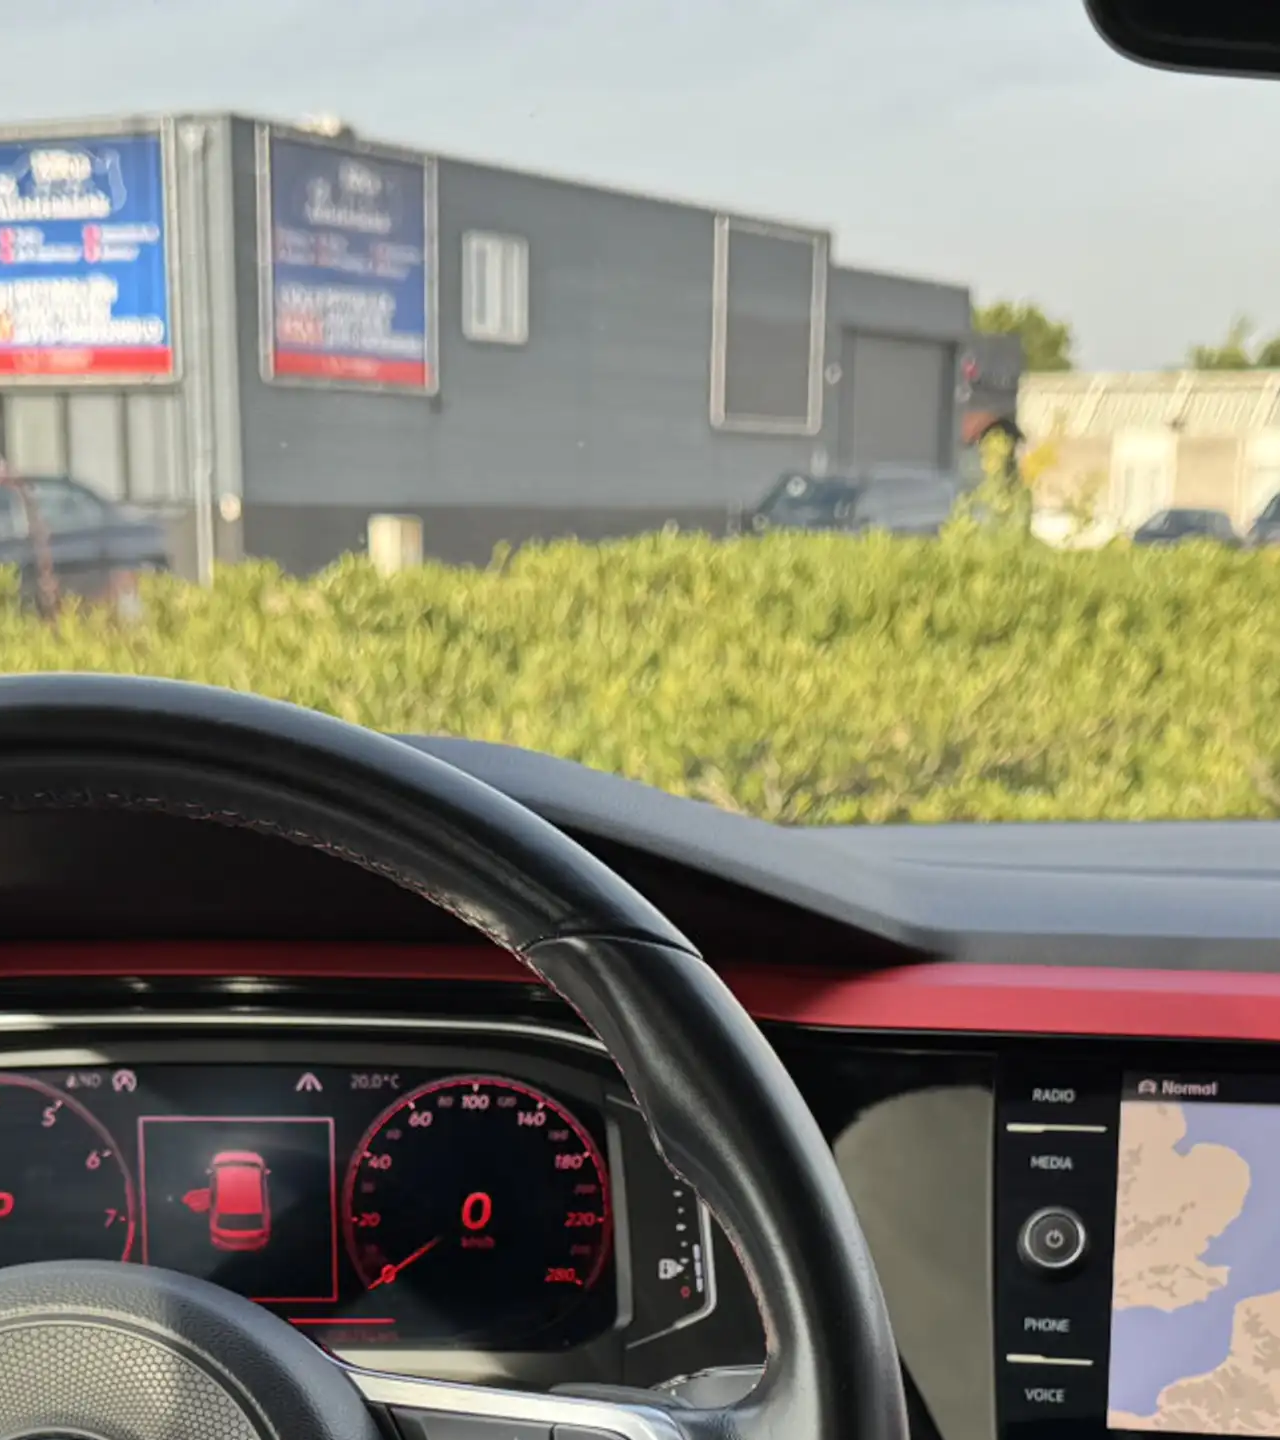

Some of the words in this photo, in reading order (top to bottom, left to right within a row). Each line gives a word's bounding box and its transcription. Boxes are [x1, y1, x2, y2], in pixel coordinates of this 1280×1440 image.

[1032, 1088, 1076, 1103] RADIO
[1162, 1080, 1218, 1096] Normal
[461, 1095, 490, 1110] 100
[42, 1110, 56, 1128] 5
[408, 1111, 433, 1127] 60
[517, 1111, 546, 1127] 140
[85, 1152, 101, 1169] 6
[368, 1154, 392, 1170] 40
[555, 1154, 583, 1169] 180
[1030, 1155, 1074, 1171] MEDIA
[104, 1208, 118, 1228] 7
[461, 1191, 492, 1230] 0
[358, 1212, 381, 1227] 20
[564, 1212, 596, 1227] 220
[1023, 1317, 1070, 1333] PHONE
[1023, 1388, 1066, 1403] VOICE
